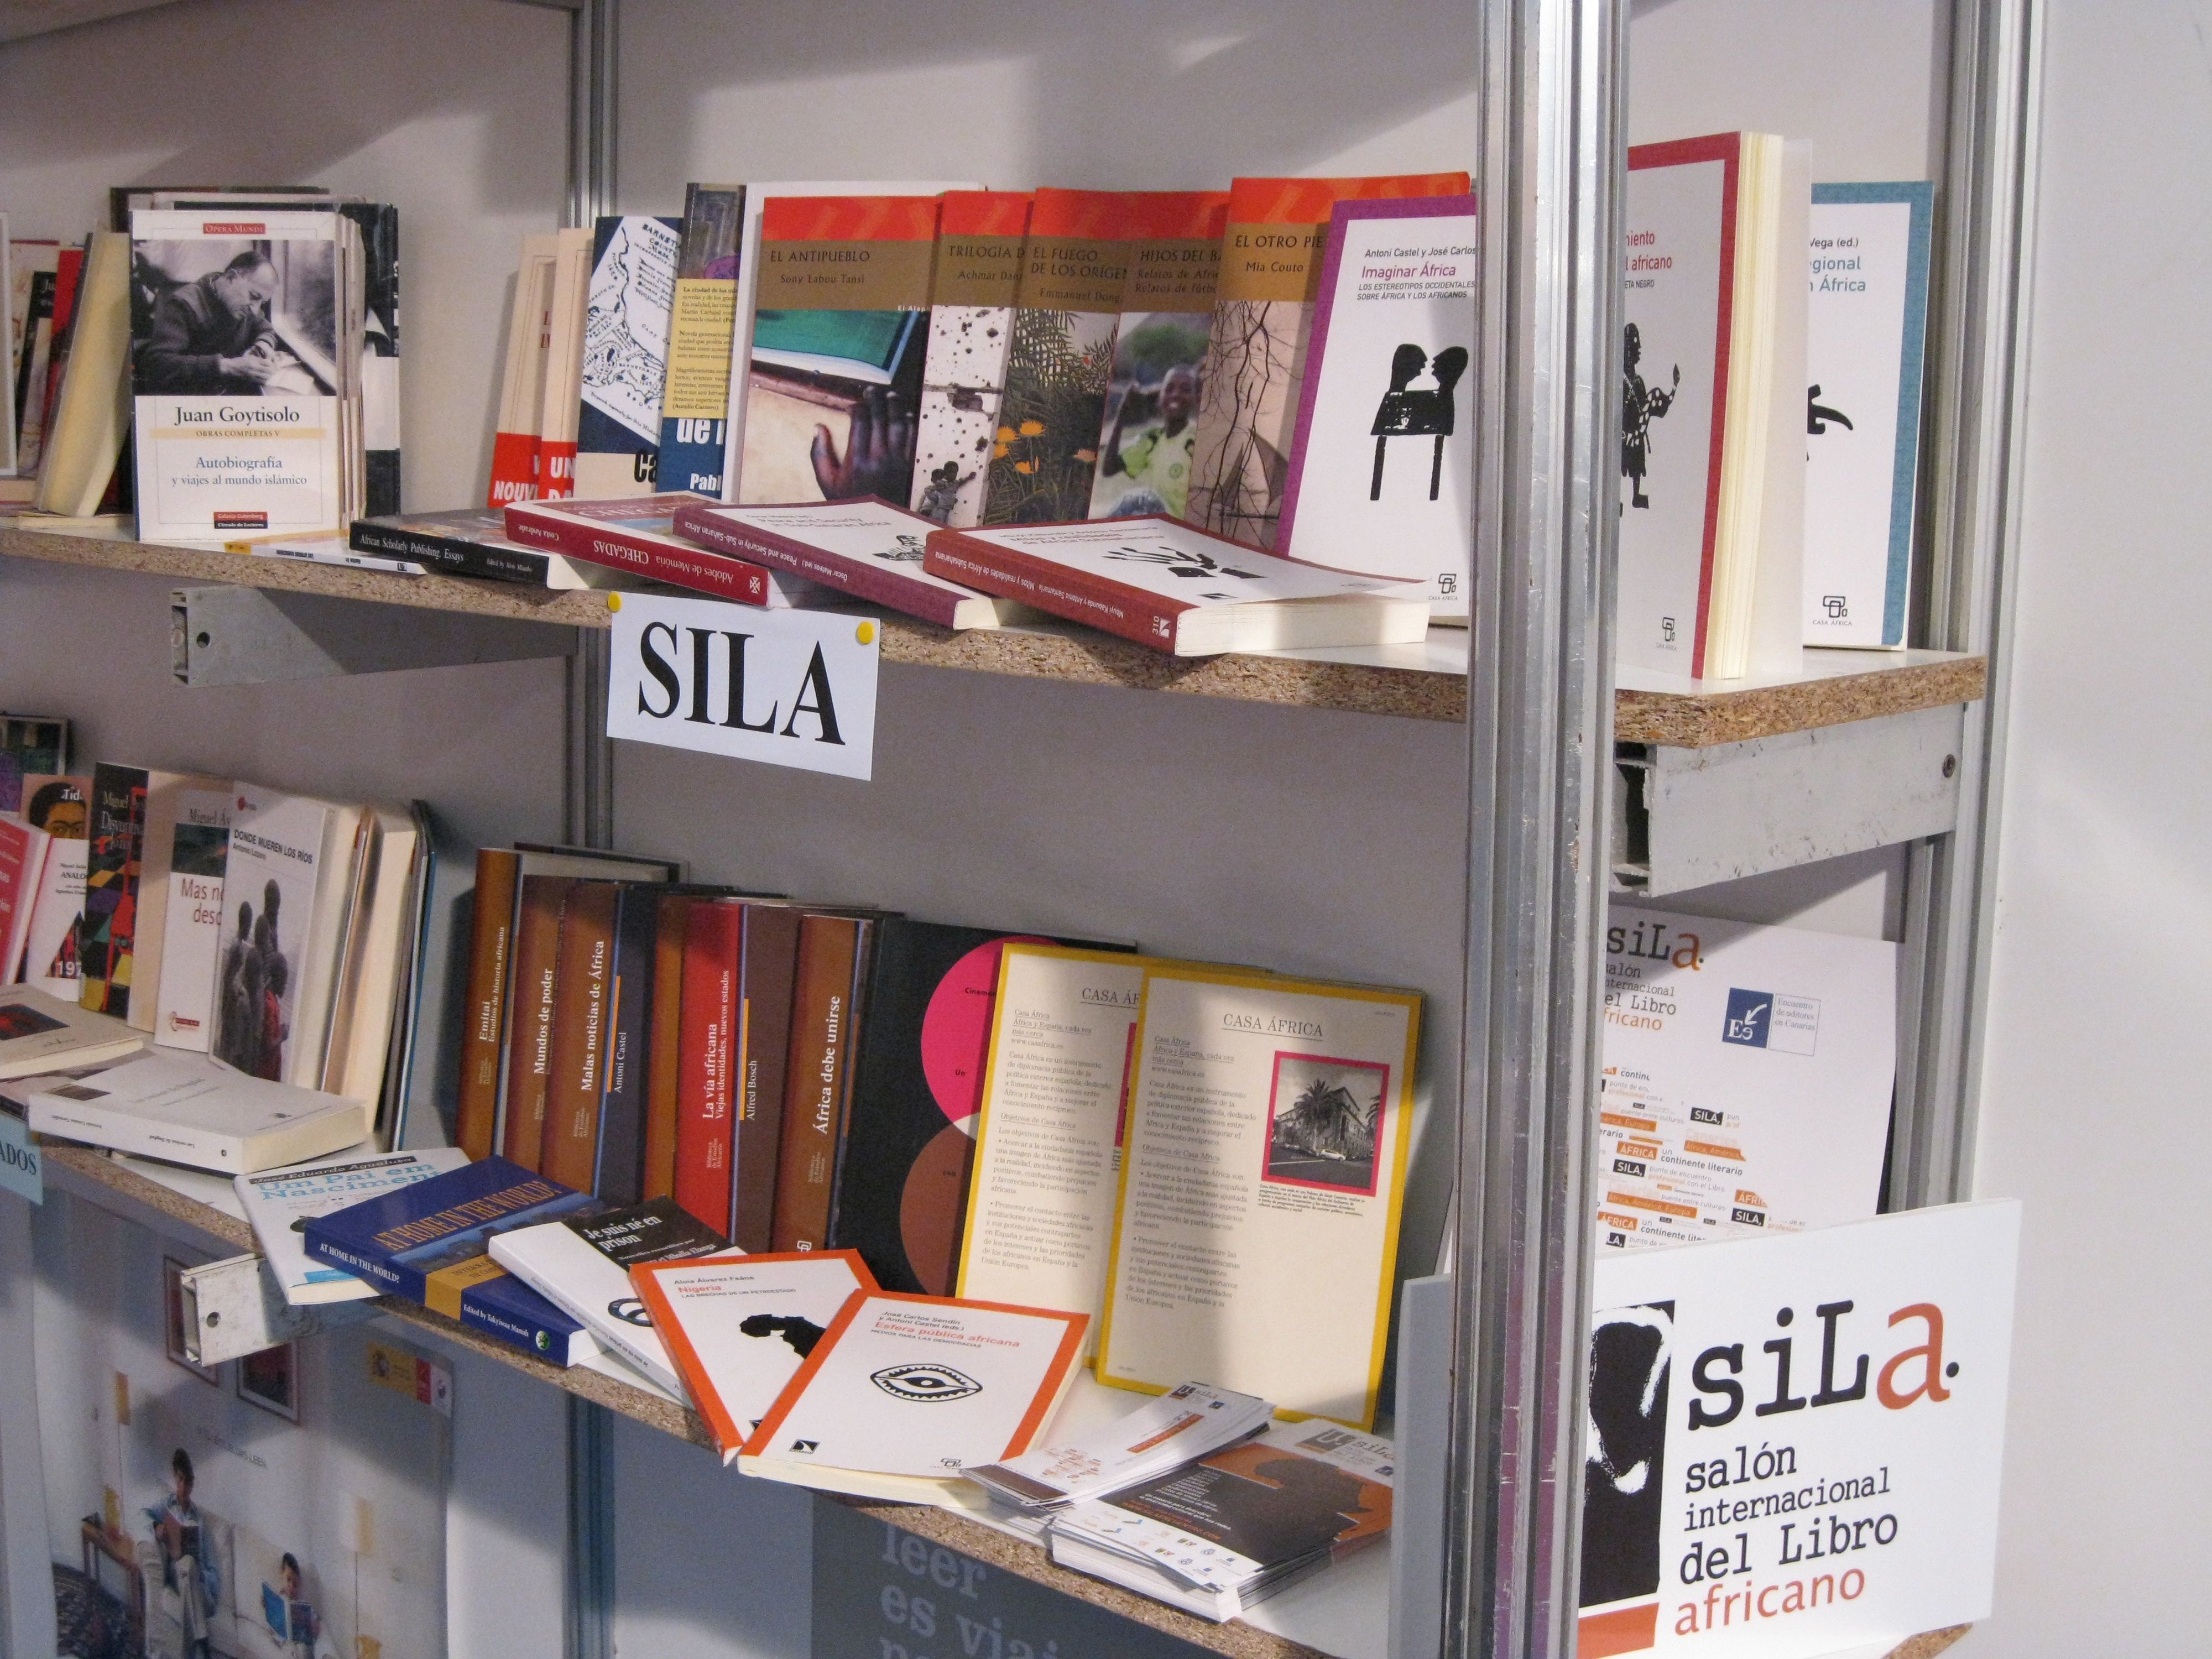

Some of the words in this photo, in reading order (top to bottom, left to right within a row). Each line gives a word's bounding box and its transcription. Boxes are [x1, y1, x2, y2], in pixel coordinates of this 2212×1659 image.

[1235, 236, 1249, 248] EL
[1255, 236, 1297, 248] OTRO
[1303, 236, 1324, 248] PIE
[1811, 238, 1833, 249] Vega
[1837, 237, 1859, 248] (ed.)
[771, 251, 783, 262] EL
[789, 251, 870, 262] ANTIPUEBLO
[1033, 247, 1046, 259] EL
[1052, 248, 1098, 262] FUEGO
[1140, 250, 1178, 263] HIJOS
[1364, 248, 1391, 258] Antoni
[1394, 248, 1419, 258] Castel
[1421, 249, 1427, 258] y
[1428, 247, 1448, 256] José
[1450, 246, 1476, 255] Carlos
[1031, 263, 1045, 274] DE
[1051, 264, 1076, 276] LOS
[1246, 262, 1265, 272] Mia
[1271, 261, 1304, 273] Couto
[1361, 265, 1417, 281] Imaginar
[1420, 261, 1456, 276] África
[1632, 255, 1672, 270] africano
[1810, 256, 1861, 274] gional
[781, 274, 802, 284] Sony
[808, 274, 836, 283] Labou
[841, 274, 864, 283] Tansi
[1374, 282, 1423, 290] ESTEREOTIPOS
[1425, 281, 1475, 289] OCCIDENTALES
[1636, 279, 1655, 288] NEGRO
[1819, 274, 1866, 291] África
[1381, 291, 1406, 300] ÁFRICA
[174, 406, 214, 425] Juan
[220, 406, 300, 426] Goytisolo
[196, 456, 282, 471] Autobiografía
[172, 477, 178, 487] y
[181, 474, 208, 487] viajes
[213, 474, 222, 484] al
[225, 474, 262, 484] mundo
[265, 473, 307, 484] islámico
[519, 525, 542, 540] Andrade
[542, 530, 560, 541] Costa
[685, 521, 701, 532] Africa
[702, 526, 737, 545] Sub-Saharan
[361, 534, 380, 547] African
[383, 538, 408, 554] Scholarly
[444, 549, 464, 562] Essays
[738, 539, 744, 547] in
[745, 539, 767, 557] Security
[768, 547, 779, 557] and
[593, 541, 649, 564] CHEGADAS
[780, 553, 797, 566] Peace
[935, 552, 967, 569] Subsahariana
[656, 555, 691, 573] Memória
[692, 564, 702, 575] de
[704, 567, 734, 584] Adobes
[990, 568, 1016, 583] realidades
[1021, 578, 1035, 591] Mitos
[638, 621, 846, 746] SILA
[234, 830, 257, 844] DONDE
[258, 837, 283, 854] MUEREN
[284, 846, 296, 858] LOS
[297, 849, 313, 864] RÍOS
[181, 878, 207, 900] Mas
[588, 941, 605, 980] África
[488, 1006, 497, 1042] Estudios
[496, 927, 504, 961] africana
[541, 968, 553, 1004] poder
[589, 983, 601, 999] de
[721, 970, 729, 1004] estados
[1631, 995, 1676, 1015] Libro
[1778, 998, 1813, 1009] Encuentro
[539, 1007, 550, 1022] de
[719, 1008, 728, 1036] nuevos
[826, 995, 841, 1044] unirse
[586, 1002, 599, 1050] noticias
[1224, 1013, 1262, 1030] CASA
[1267, 1016, 1323, 1036] ÁFRICA
[1786, 1020, 1815, 1030] Canarias
[534, 1024, 548, 1074] Mundos
[617, 1032, 627, 1060] Castel
[705, 1023, 717, 1071] africana
[581, 1053, 595, 1091] Malas
[748, 1060, 758, 1088] Bosch
[821, 1047, 836, 1083] debe
[614, 1062, 624, 1094] Antoni
[703, 1080, 714, 1097] vía
[703, 1102, 714, 1119] La
[716, 1097, 726, 1119] Viejas
[747, 1090, 757, 1121] Alfred
[812, 1088, 832, 1134] África
[1620, 1144, 1655, 1159] ÁFRICA
[1661, 1156, 1705, 1169] continente
[1708, 1162, 1743, 1176] literario
[255, 1179, 314, 1191] Um
[322, 1170, 376, 1184] Pai
[385, 1163, 436, 1176] em
[583, 1228, 603, 1239] Je
[601, 1223, 629, 1237] suis
[626, 1218, 645, 1230] né
[643, 1216, 662, 1226] en
[597, 1234, 642, 1252] prison
[320, 1243, 330, 1253] AT
[329, 1245, 349, 1261] HOME
[349, 1254, 358, 1265] IN
[358, 1258, 373, 1273] THE
[373, 1265, 400, 1284] WORLD?
[678, 1285, 722, 1293] Nigeria
[875, 1322, 915, 1333] Esfera
[919, 1328, 964, 1339] pública
[968, 1335, 1020, 1348] africana
[1684, 1441, 1797, 1495] salón
[1684, 1468, 1891, 1531] internacional
[1681, 1533, 1752, 1584] del
[1778, 1513, 1898, 1566] Libro
[880, 1584, 936, 1638] es
[1674, 1568, 1865, 1636] africano
